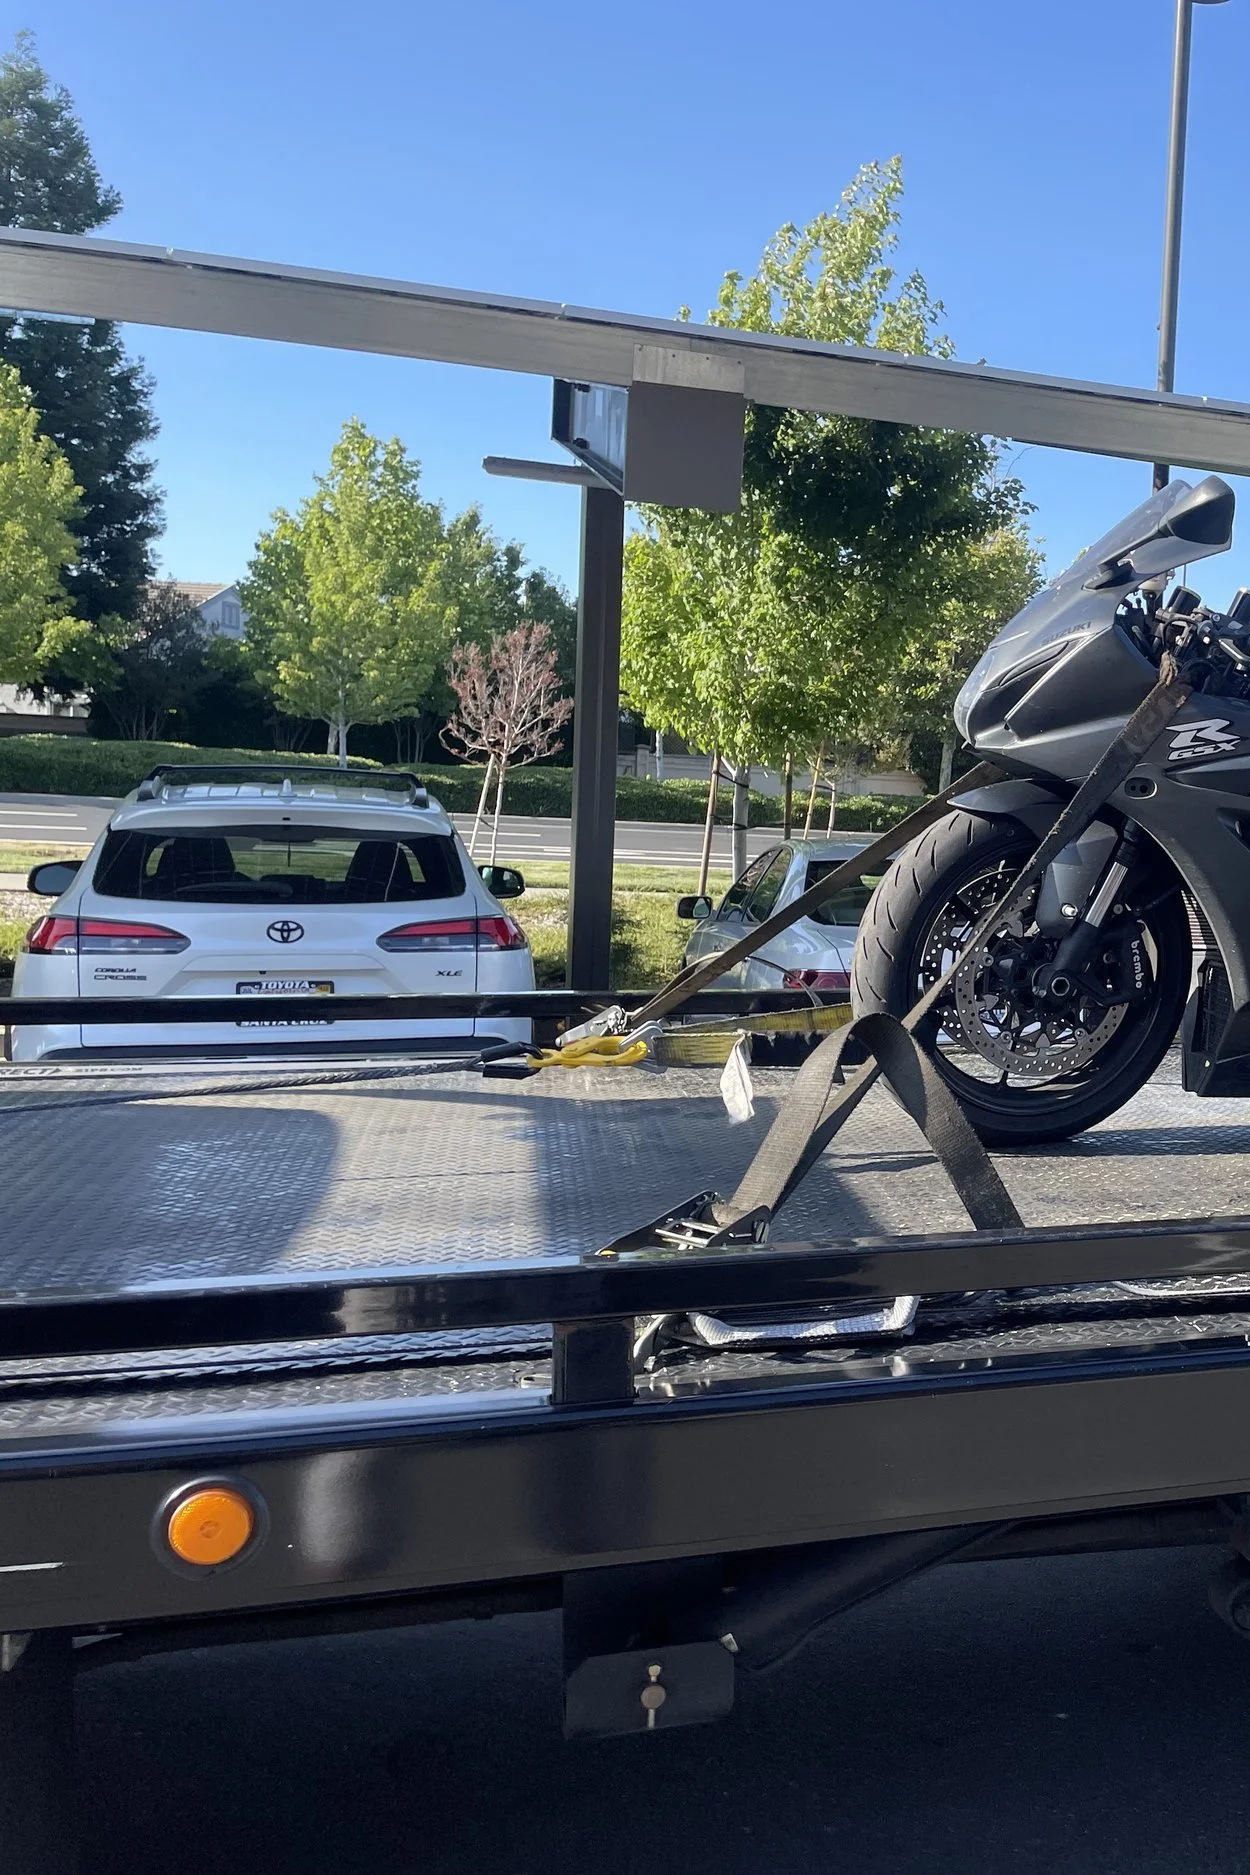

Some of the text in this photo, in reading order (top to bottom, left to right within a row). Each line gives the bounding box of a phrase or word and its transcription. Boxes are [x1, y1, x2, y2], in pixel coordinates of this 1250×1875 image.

[1165, 718, 1241, 749] R
[1167, 739, 1241, 761] GSX
[434, 969, 463, 977] XLE
[1131, 939, 1145, 989] brembo
[261, 981, 310, 990] TOYOTA
